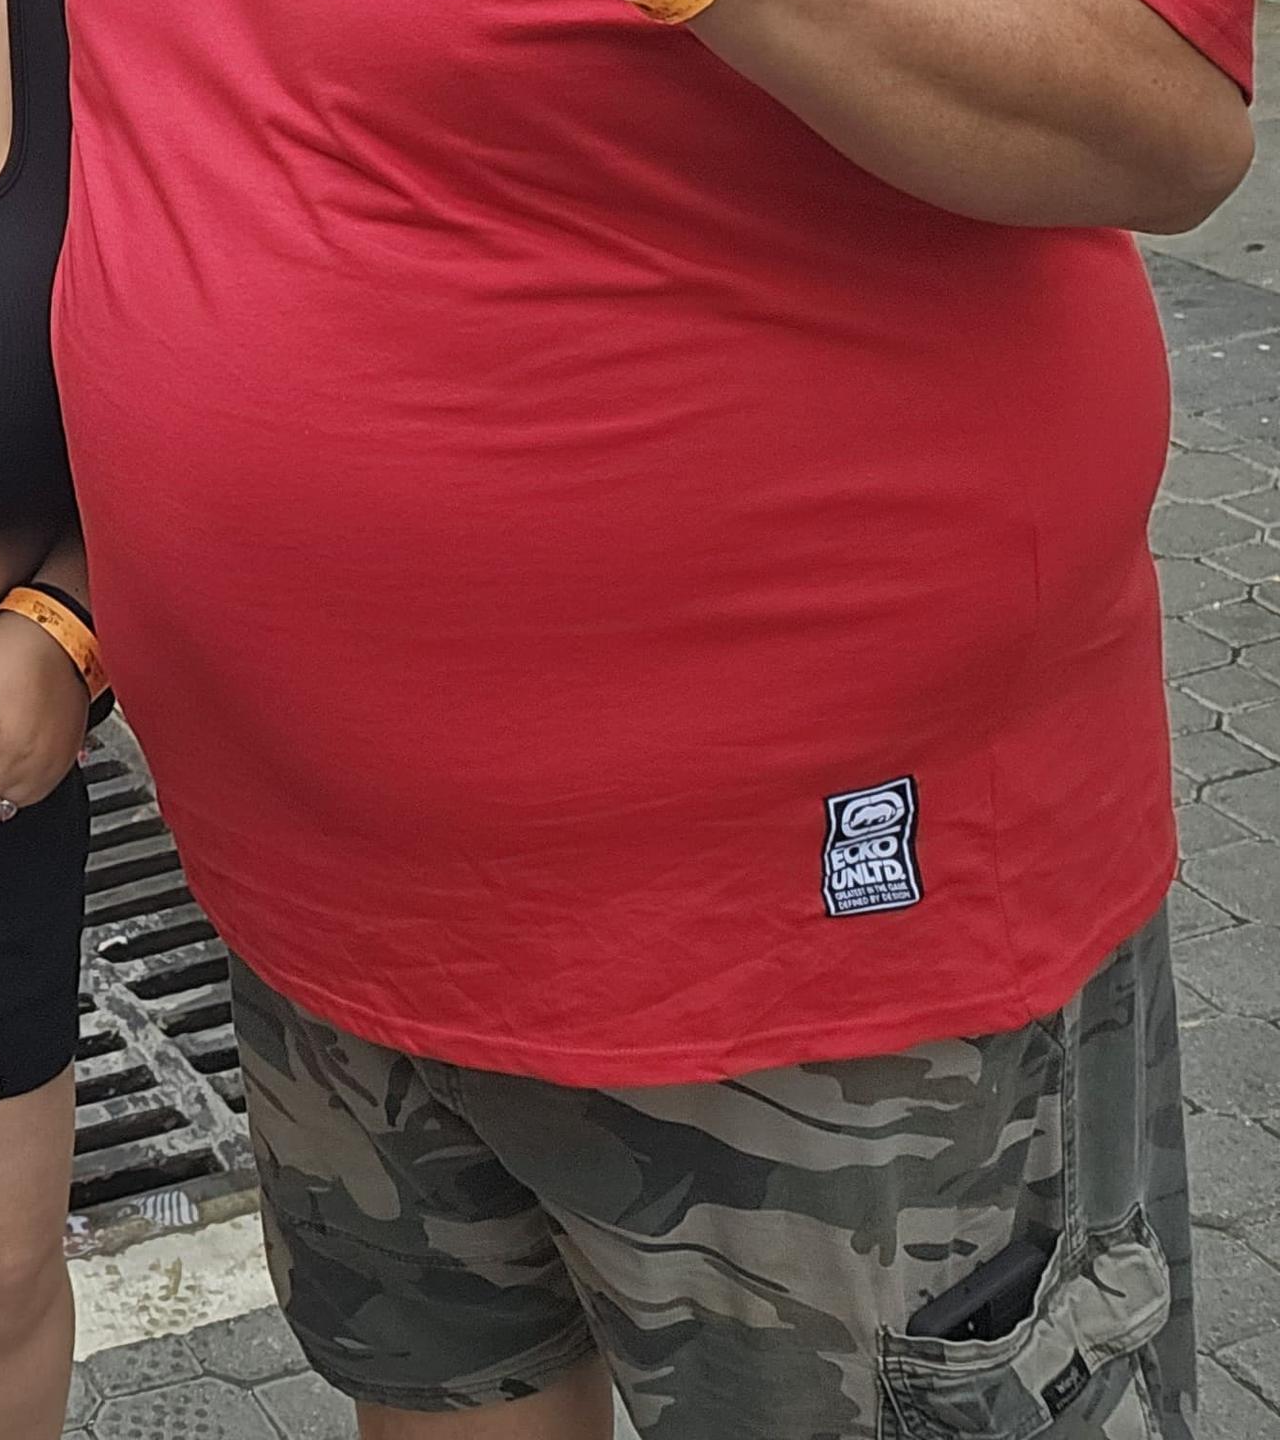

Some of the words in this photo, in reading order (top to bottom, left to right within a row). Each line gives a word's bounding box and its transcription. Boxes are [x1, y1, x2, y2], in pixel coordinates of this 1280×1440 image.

[830, 836, 898, 871] ECKO
[832, 859, 906, 890] UNLTD.
[869, 894, 880, 904] BY
